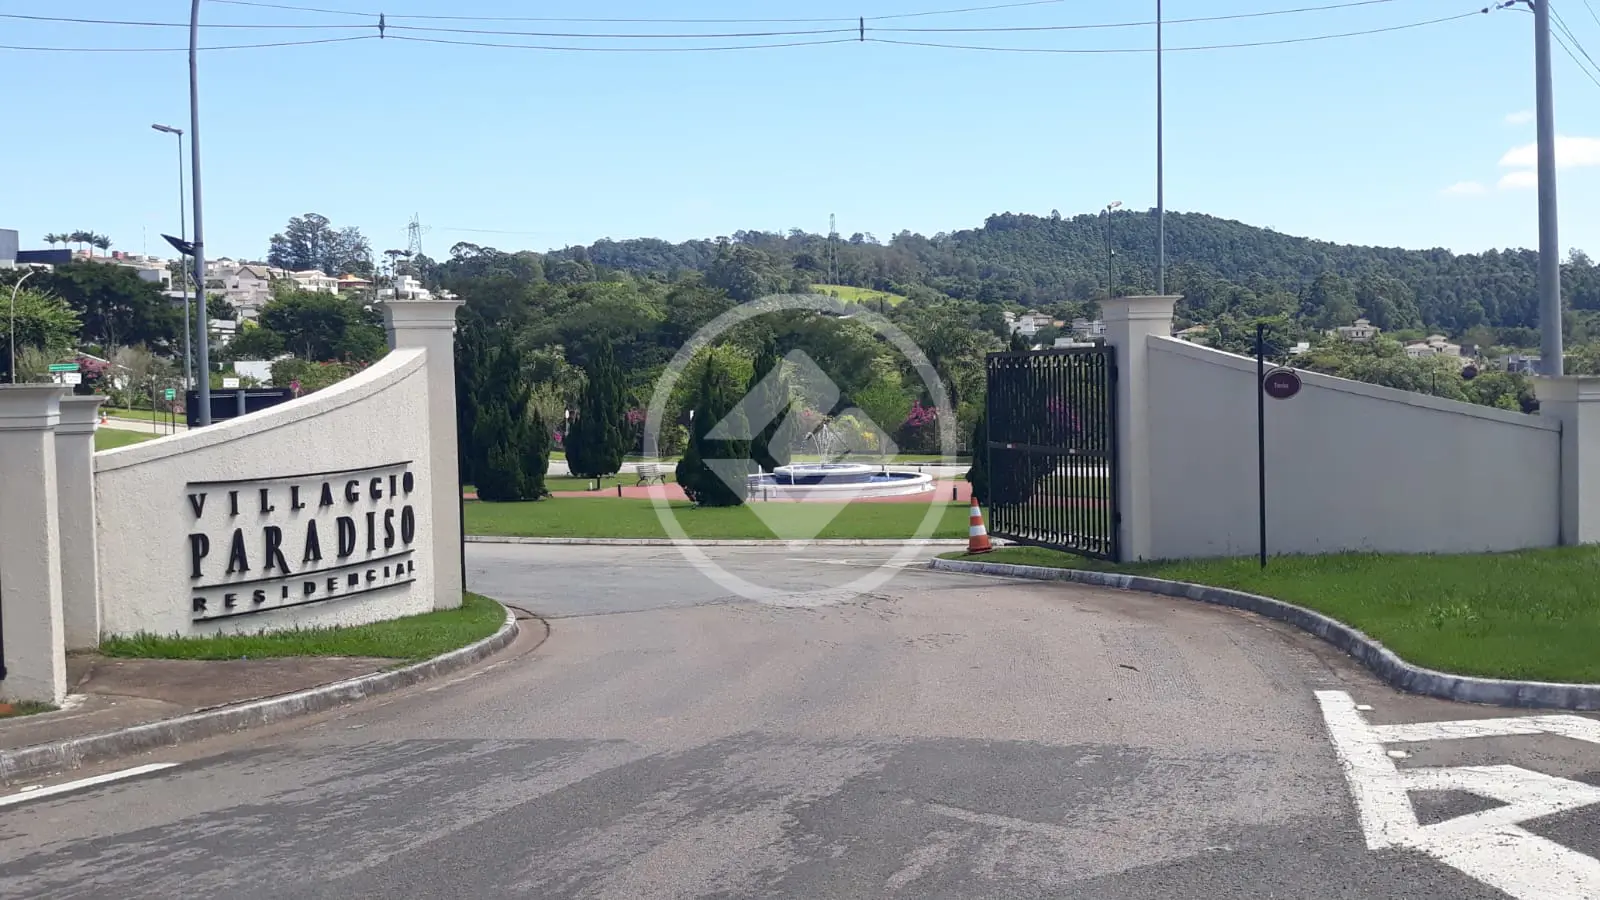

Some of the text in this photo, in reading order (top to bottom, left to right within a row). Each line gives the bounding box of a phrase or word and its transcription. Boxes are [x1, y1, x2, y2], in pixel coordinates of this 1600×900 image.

[187, 471, 414, 519] VILLAGGIO
[188, 505, 415, 578] PARADISO
[192, 560, 416, 612] RESIDENCIAL
